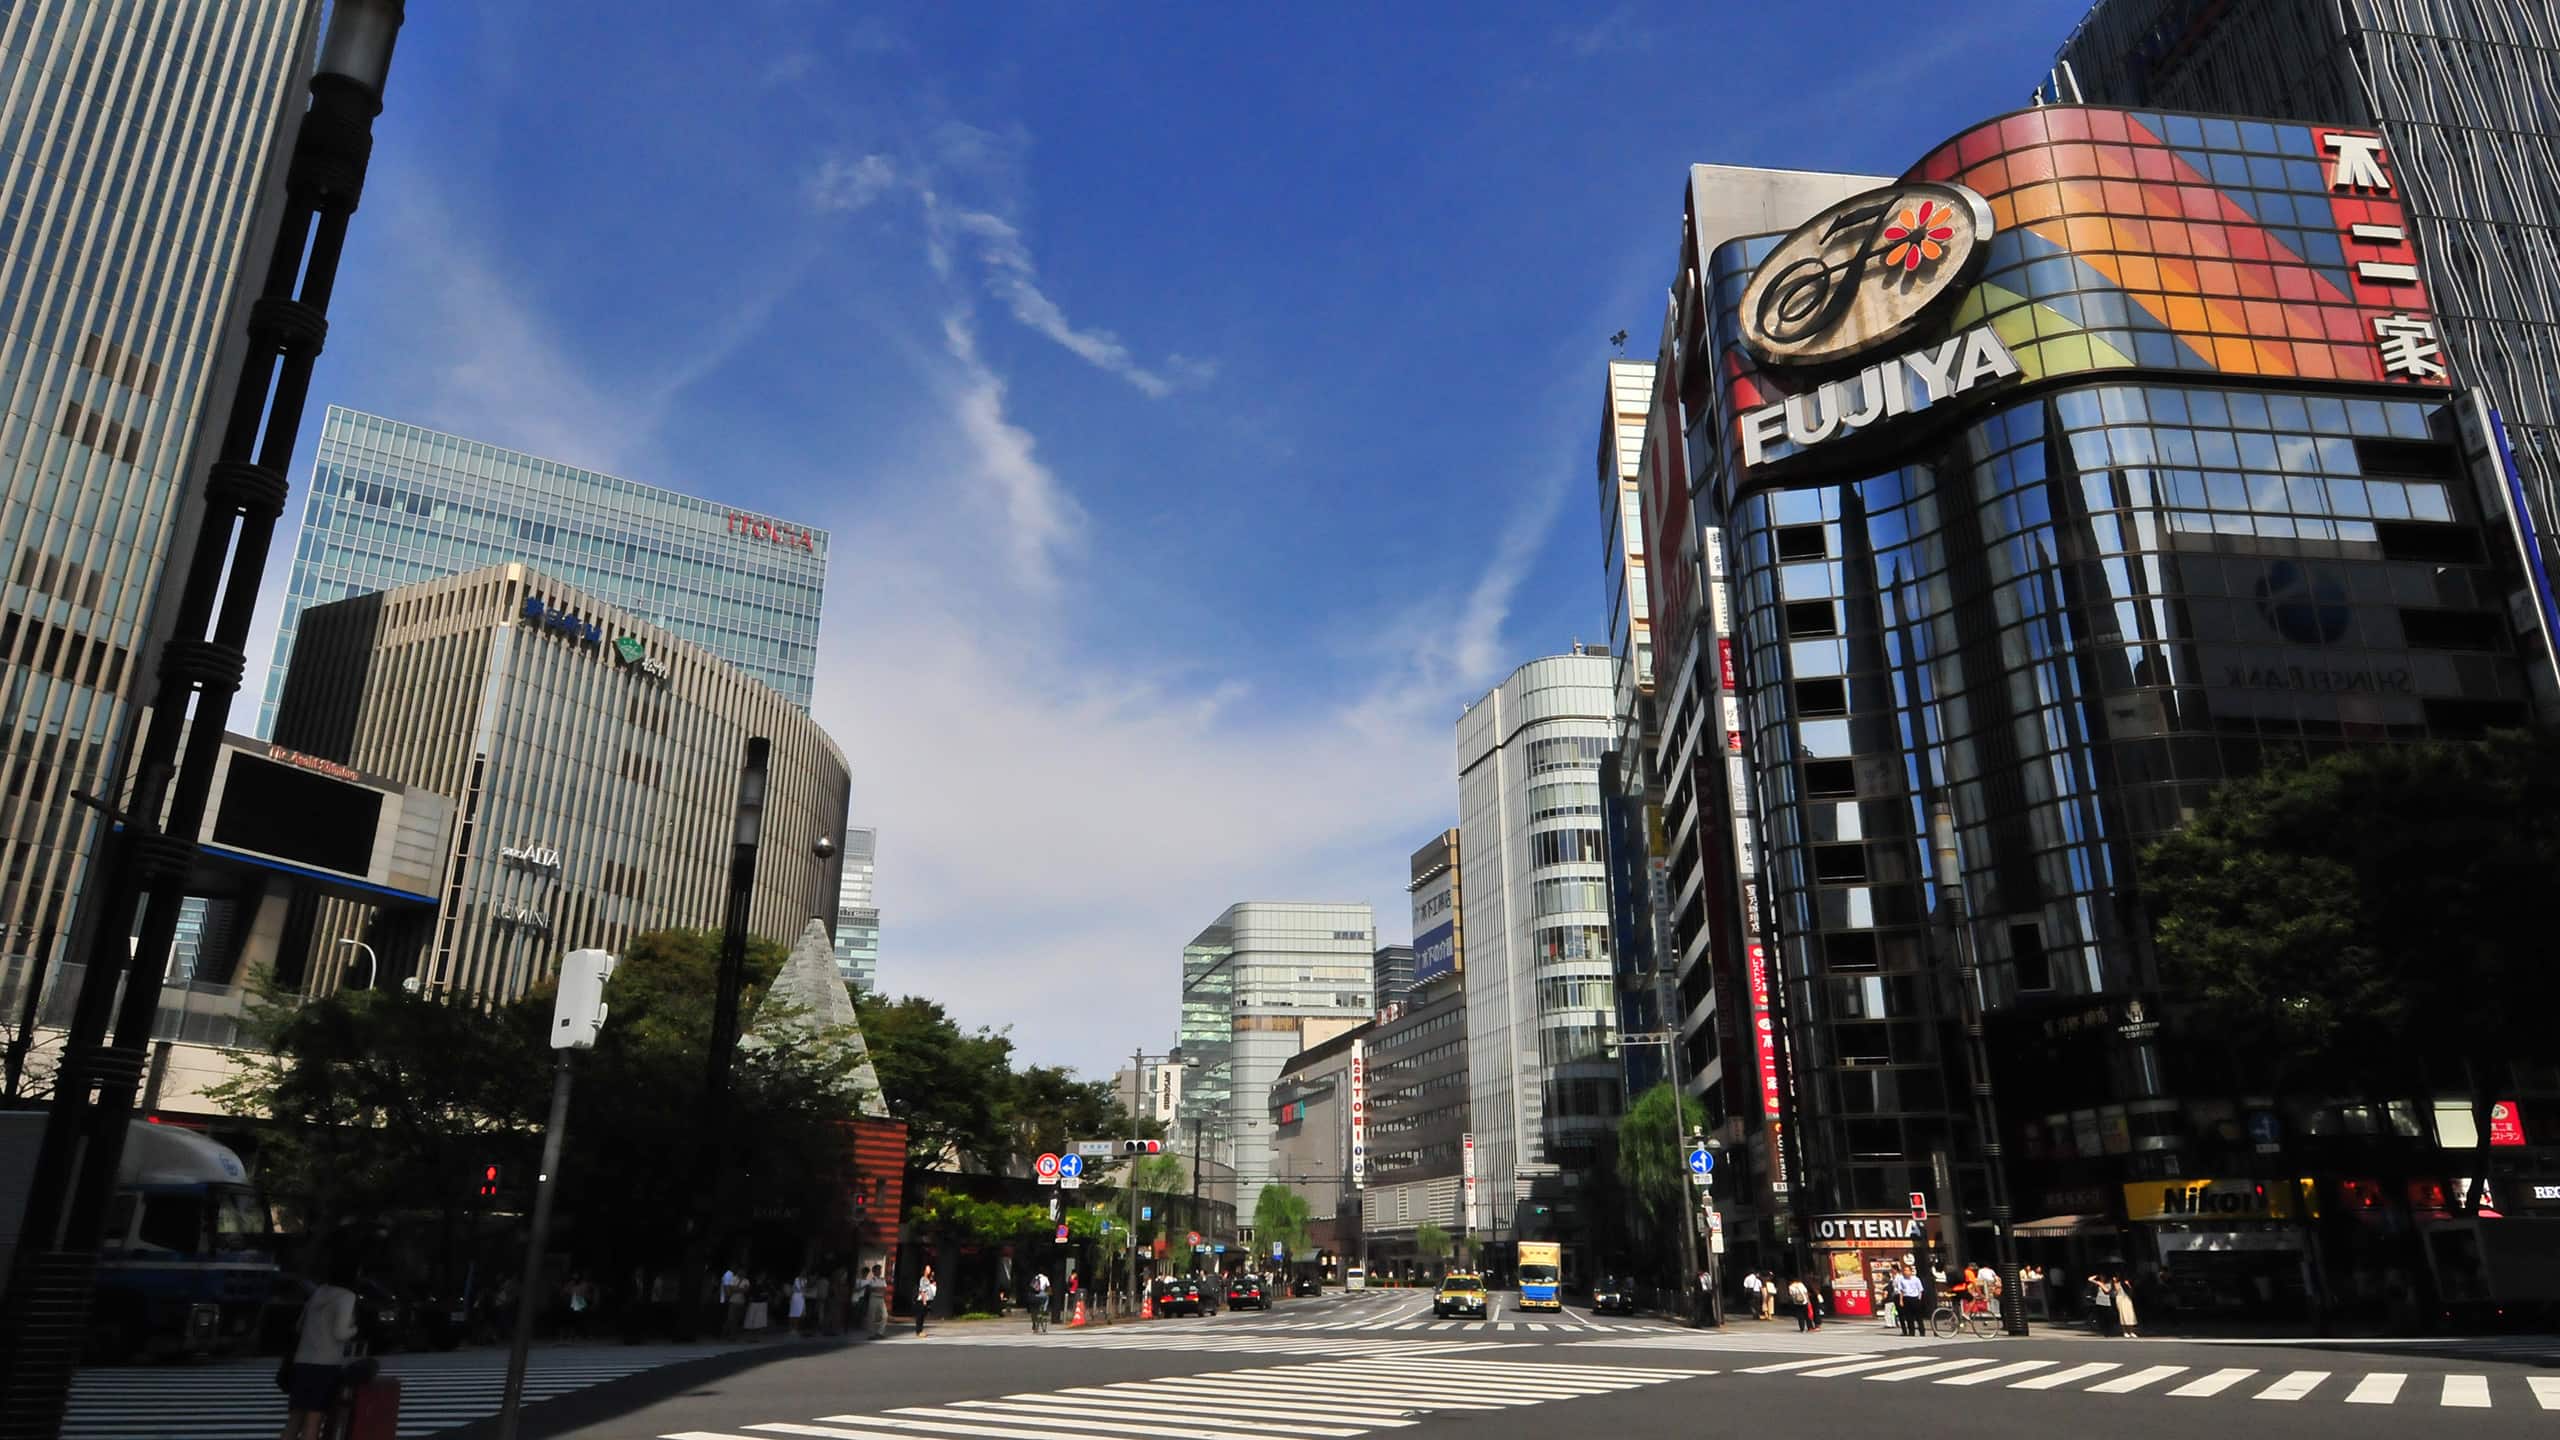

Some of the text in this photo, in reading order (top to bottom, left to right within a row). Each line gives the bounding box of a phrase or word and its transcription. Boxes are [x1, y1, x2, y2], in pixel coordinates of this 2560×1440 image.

[2324, 131, 2447, 381] 不二家
[1740, 325, 2023, 468] FUJIYA
[1762, 1034, 1779, 1090] 不二家
[1814, 1219, 1921, 1239] LOTTERIA
